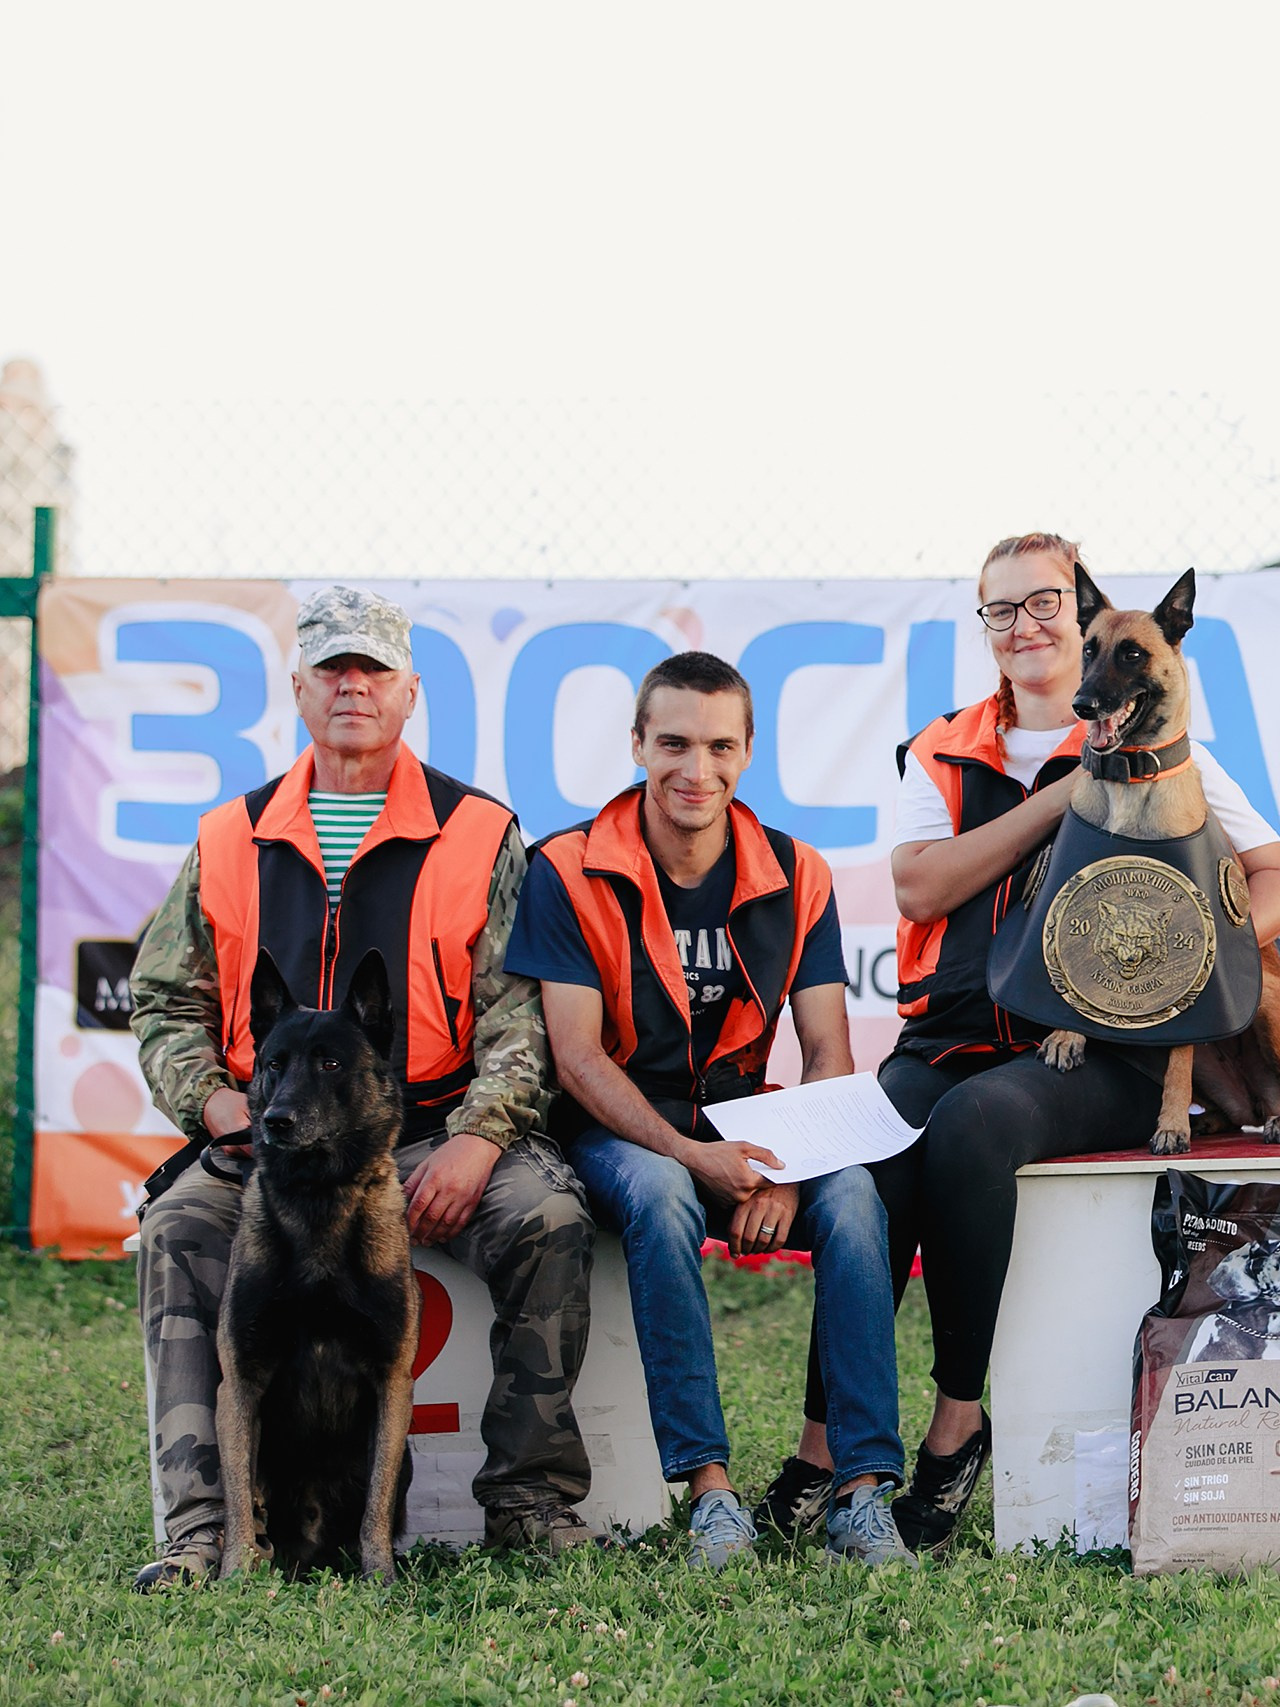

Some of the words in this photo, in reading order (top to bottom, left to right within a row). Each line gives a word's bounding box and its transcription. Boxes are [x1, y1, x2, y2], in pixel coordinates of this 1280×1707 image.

[1070, 918, 1091, 936] 20
[1173, 932, 1195, 950] 24
[1090, 970, 1121, 994] КУБОК
[1127, 977, 1164, 995] СЕВЕРА
[1106, 997, 1143, 1010] ВОЛОГДА
[1205, 1218, 1238, 1236] ADULTO
[1174, 1410, 1250, 1436] Natural
[1186, 1443, 1215, 1460] SKIN
[1219, 1441, 1253, 1456] CARE
[1130, 1429, 1142, 1502] CORDERO
[1185, 1457, 1216, 1468] CUIDADO
[1217, 1456, 1227, 1465] DE
[1228, 1456, 1237, 1464] LA
[1238, 1455, 1255, 1464] PIEL
[1183, 1476, 1200, 1488] SIN
[1201, 1474, 1229, 1485] TRIGO
[1183, 1491, 1200, 1503] SIN
[1200, 1489, 1226, 1501] SOJA
[1172, 1513, 1191, 1526] CON
[1193, 1512, 1268, 1524] ANTIOXIDANTES
